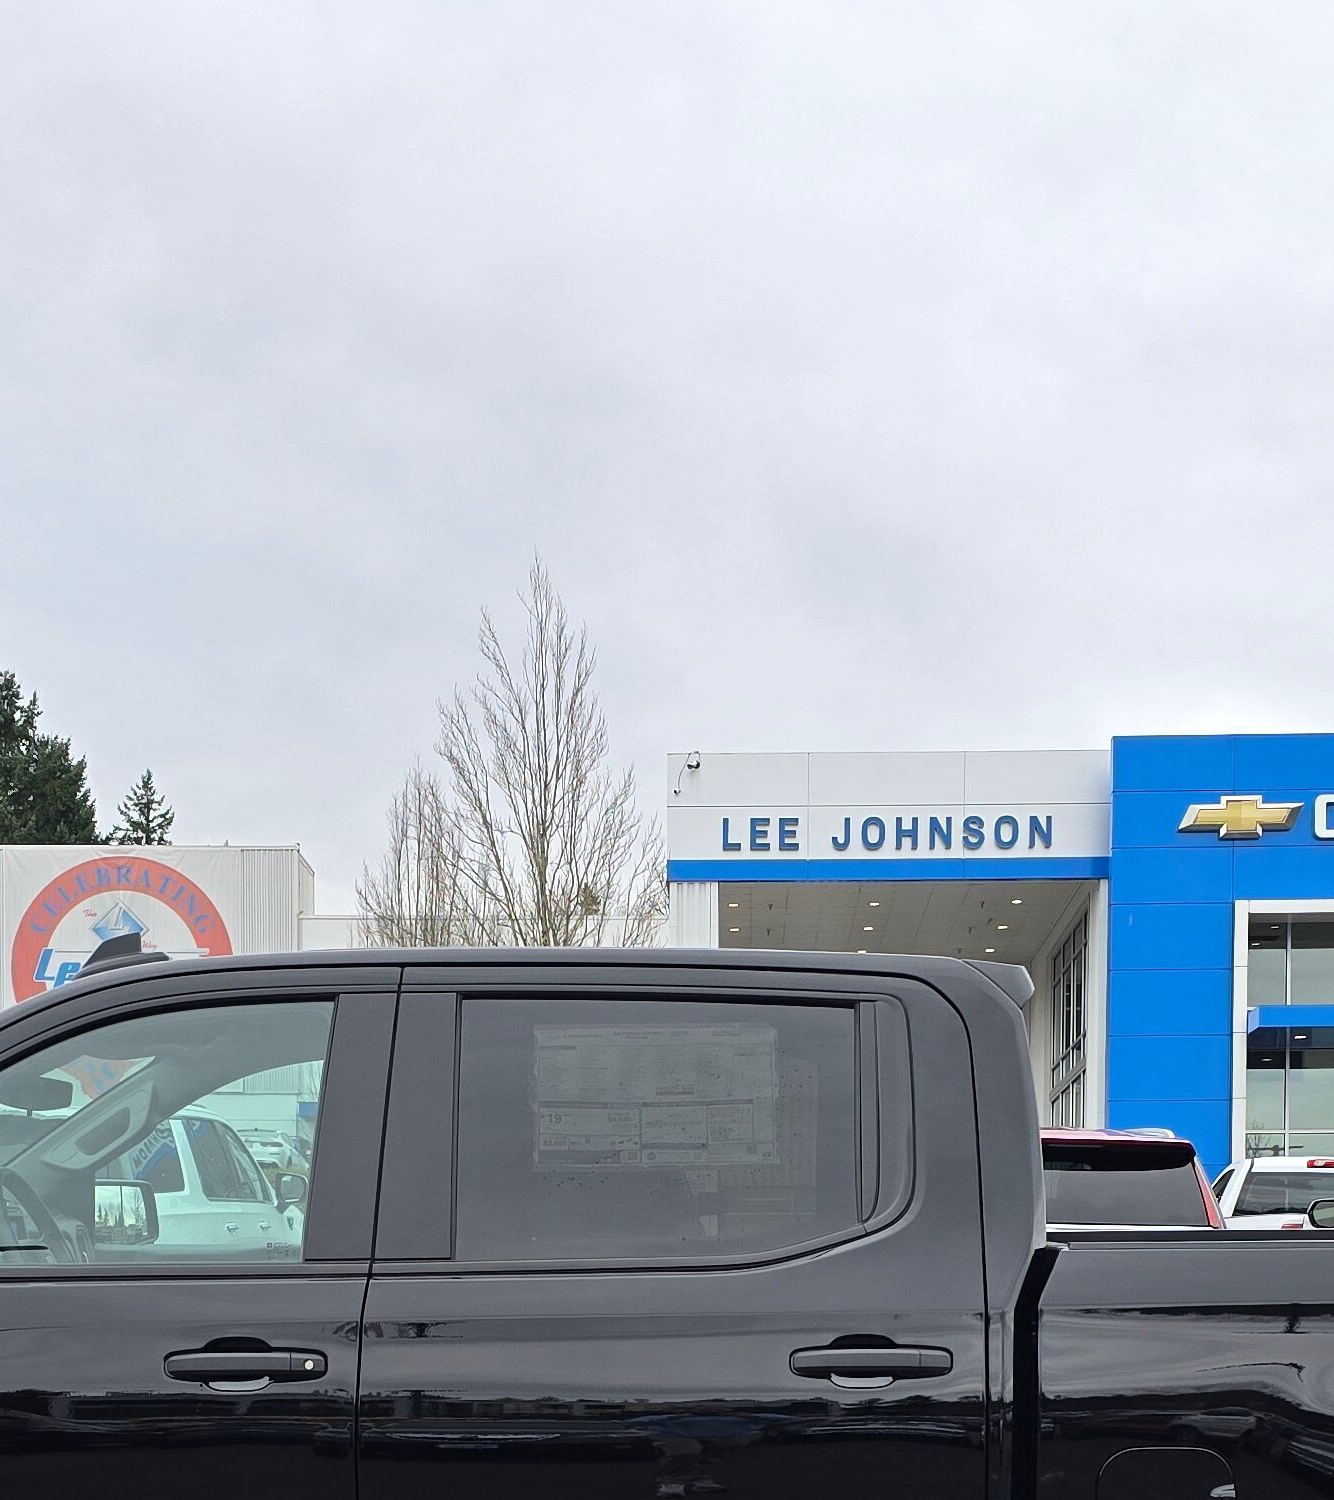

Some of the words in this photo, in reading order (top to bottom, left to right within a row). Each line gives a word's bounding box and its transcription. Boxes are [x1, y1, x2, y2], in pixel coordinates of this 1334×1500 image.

[722, 817, 800, 851] LEE
[831, 815, 1053, 851] JOHNSON
[31, 863, 213, 935] CELEBRATING
